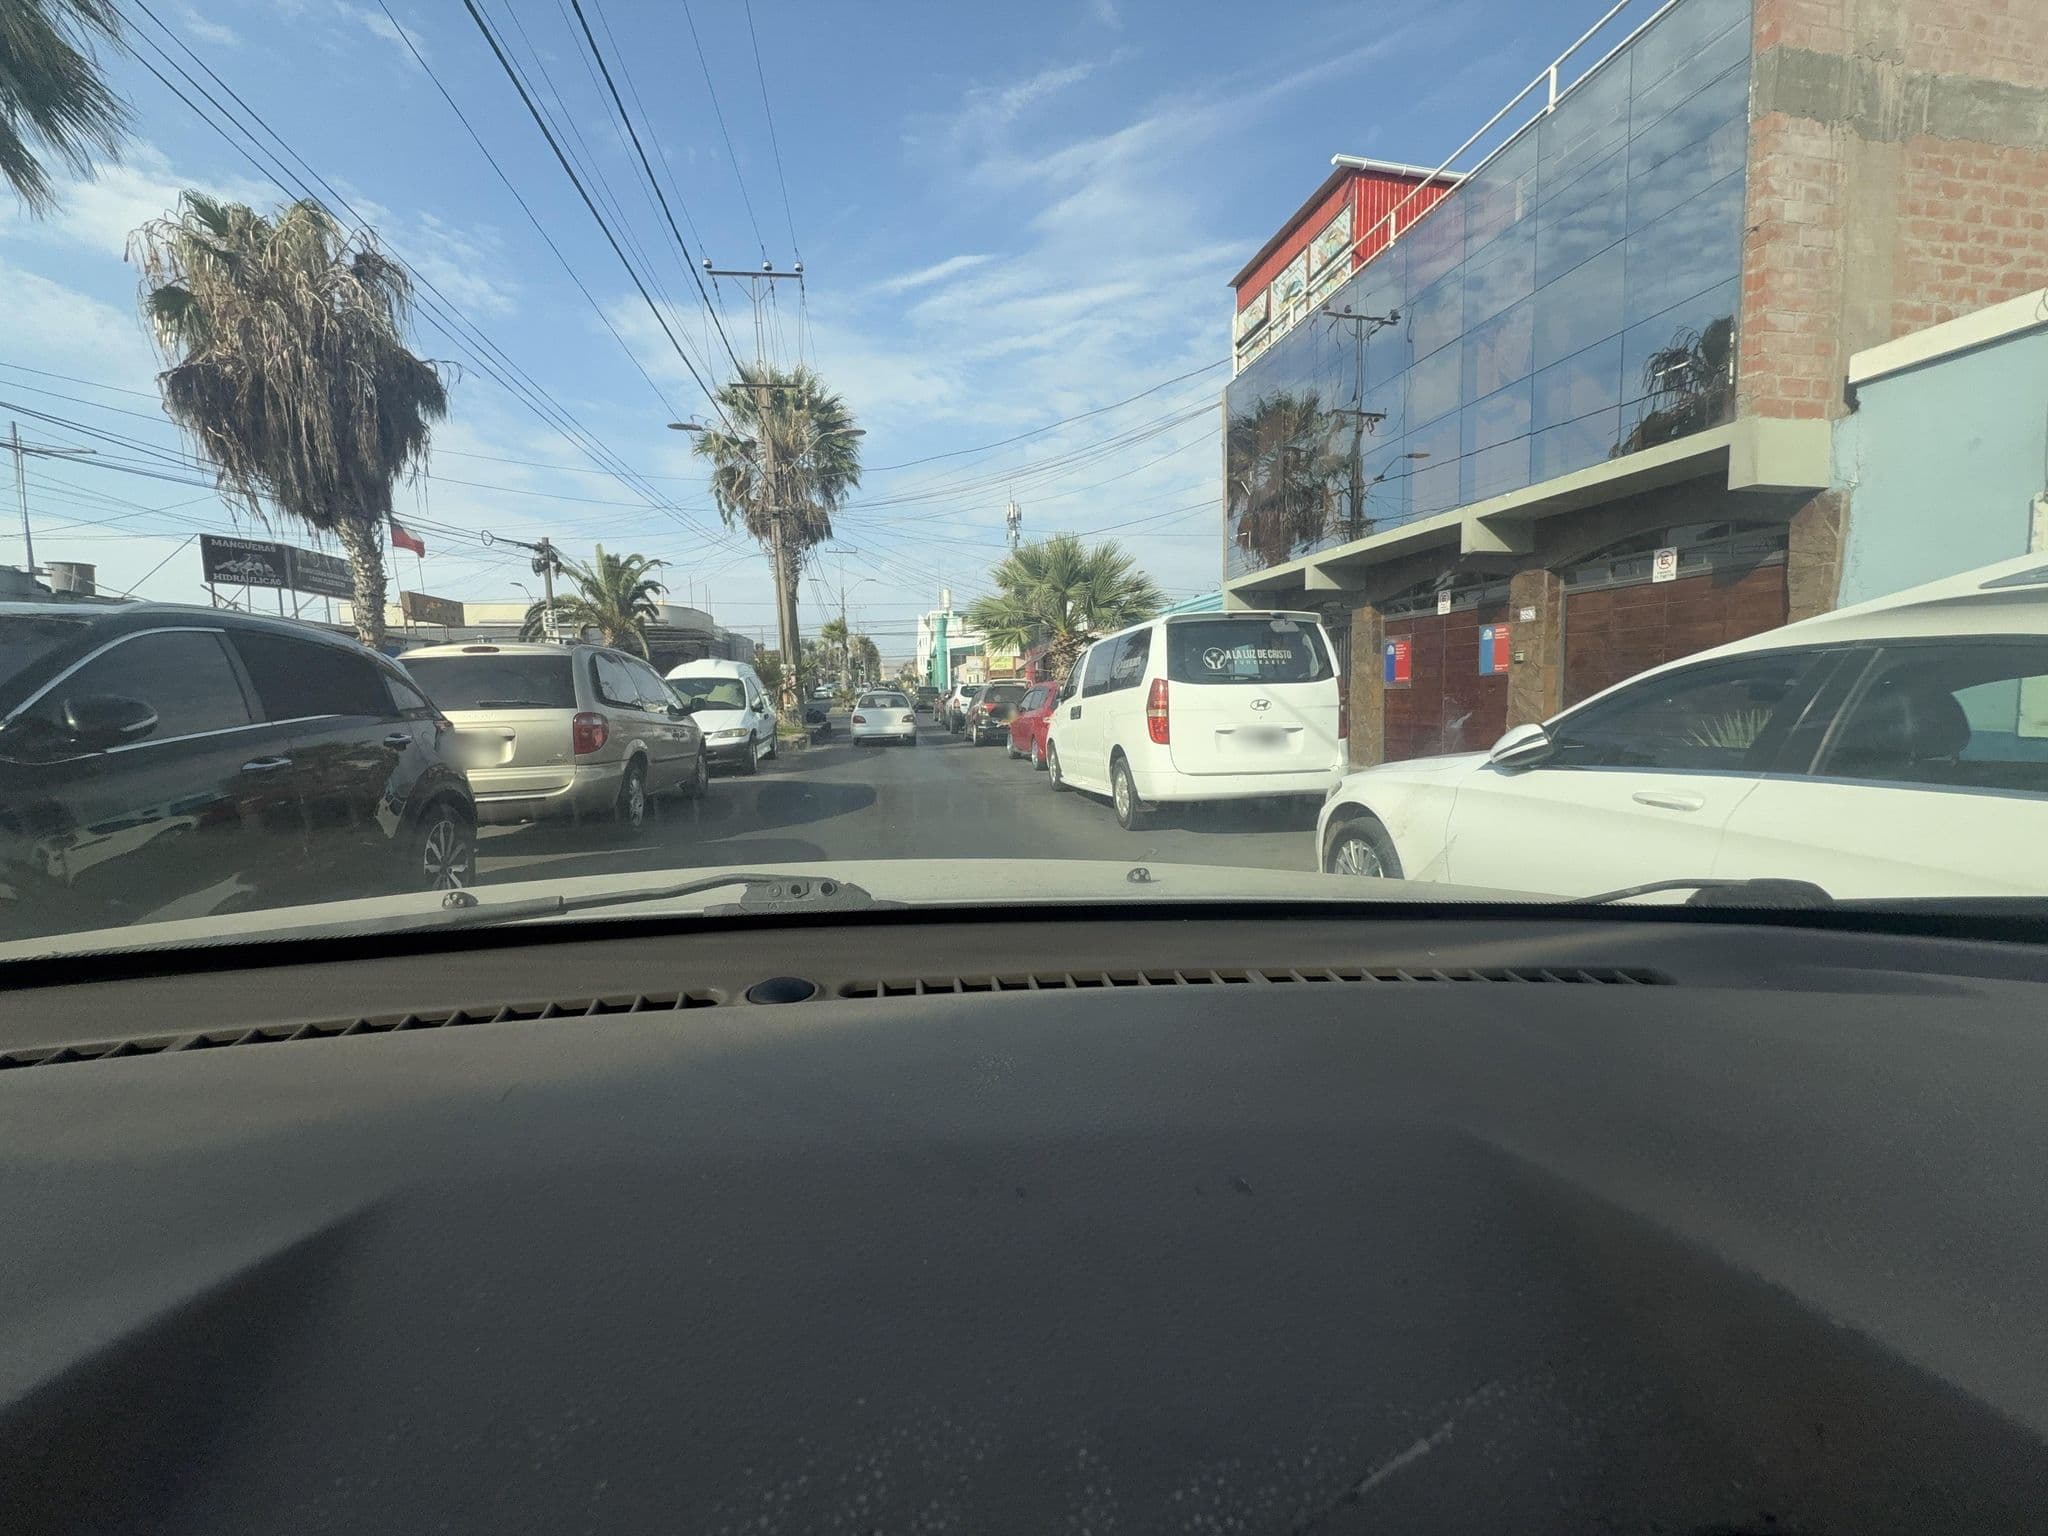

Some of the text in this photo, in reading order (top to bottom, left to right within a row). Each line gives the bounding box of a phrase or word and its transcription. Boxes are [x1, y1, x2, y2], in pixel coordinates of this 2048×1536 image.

[211, 538, 276, 552] MANGUERAS
[1226, 649, 1292, 660] A LA LUZ DE CRISTO
